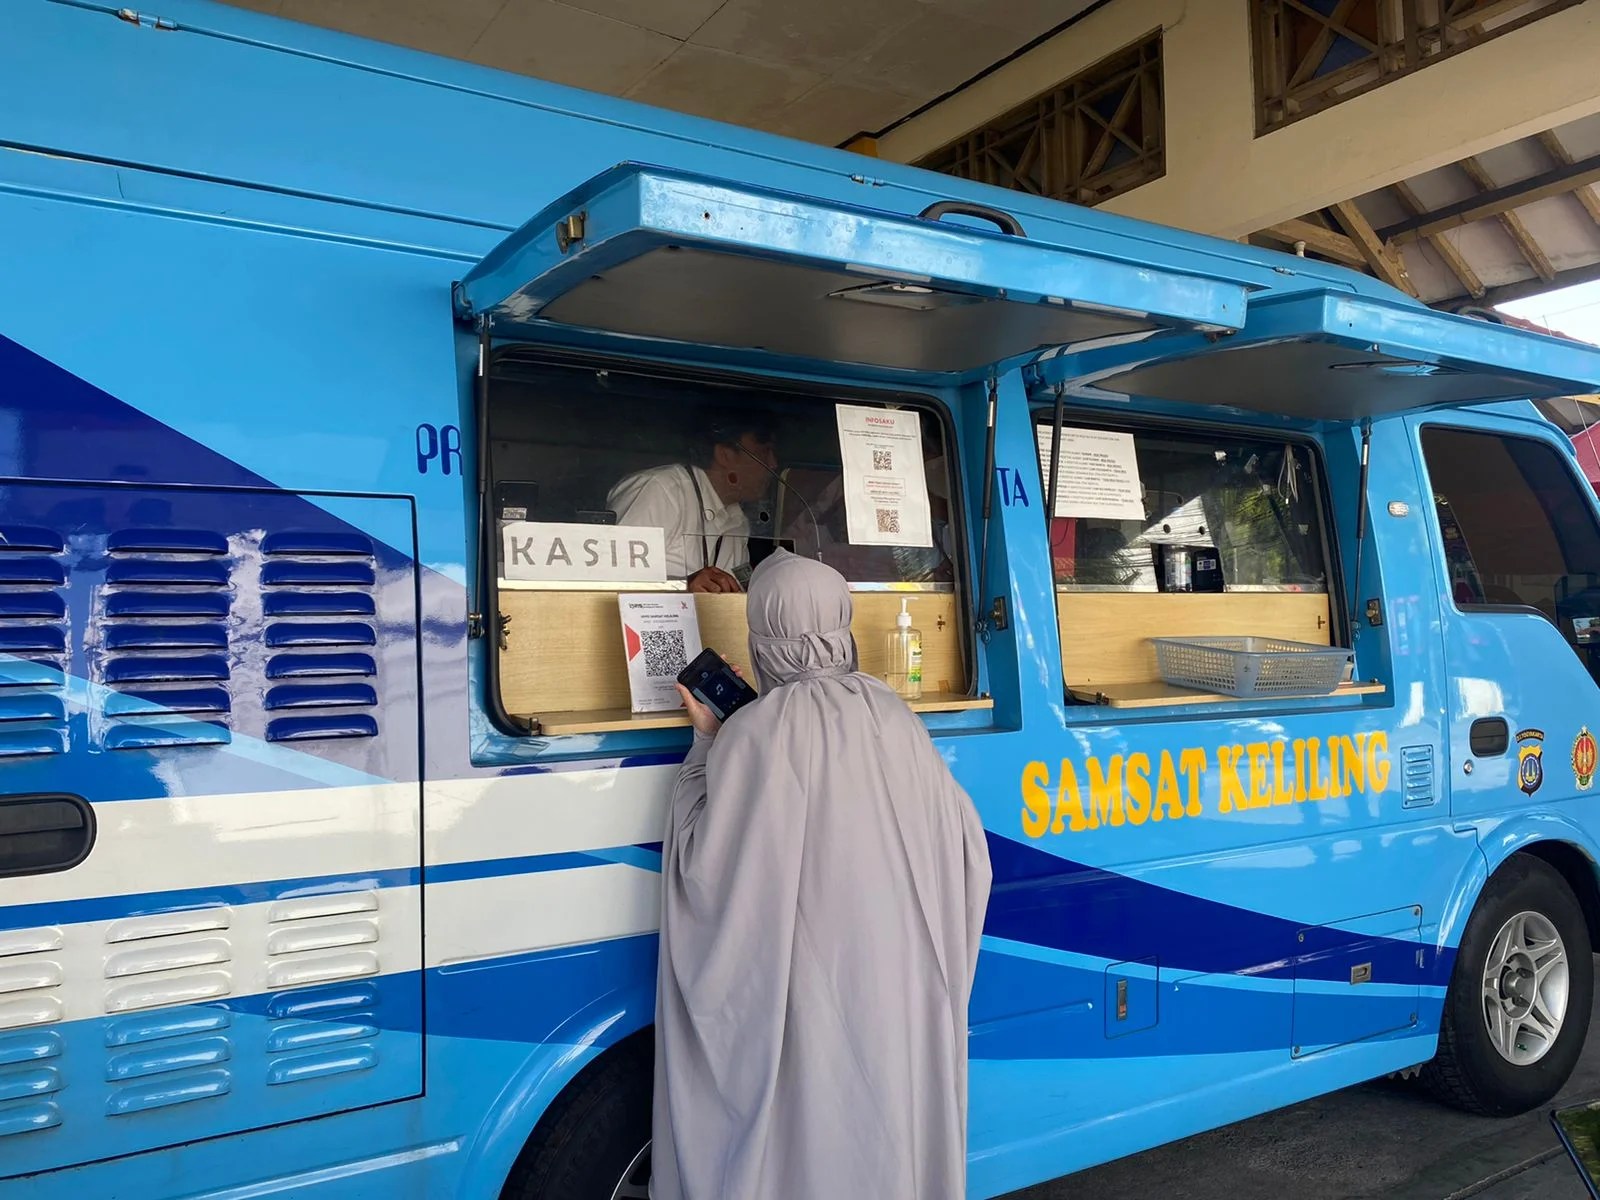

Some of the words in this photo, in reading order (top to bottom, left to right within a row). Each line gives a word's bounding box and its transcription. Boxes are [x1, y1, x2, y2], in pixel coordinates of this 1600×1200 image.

[511, 535, 651, 569] KASIR
[1021, 747, 1207, 838] SAMSAT
[1217, 731, 1391, 814] KELILING
